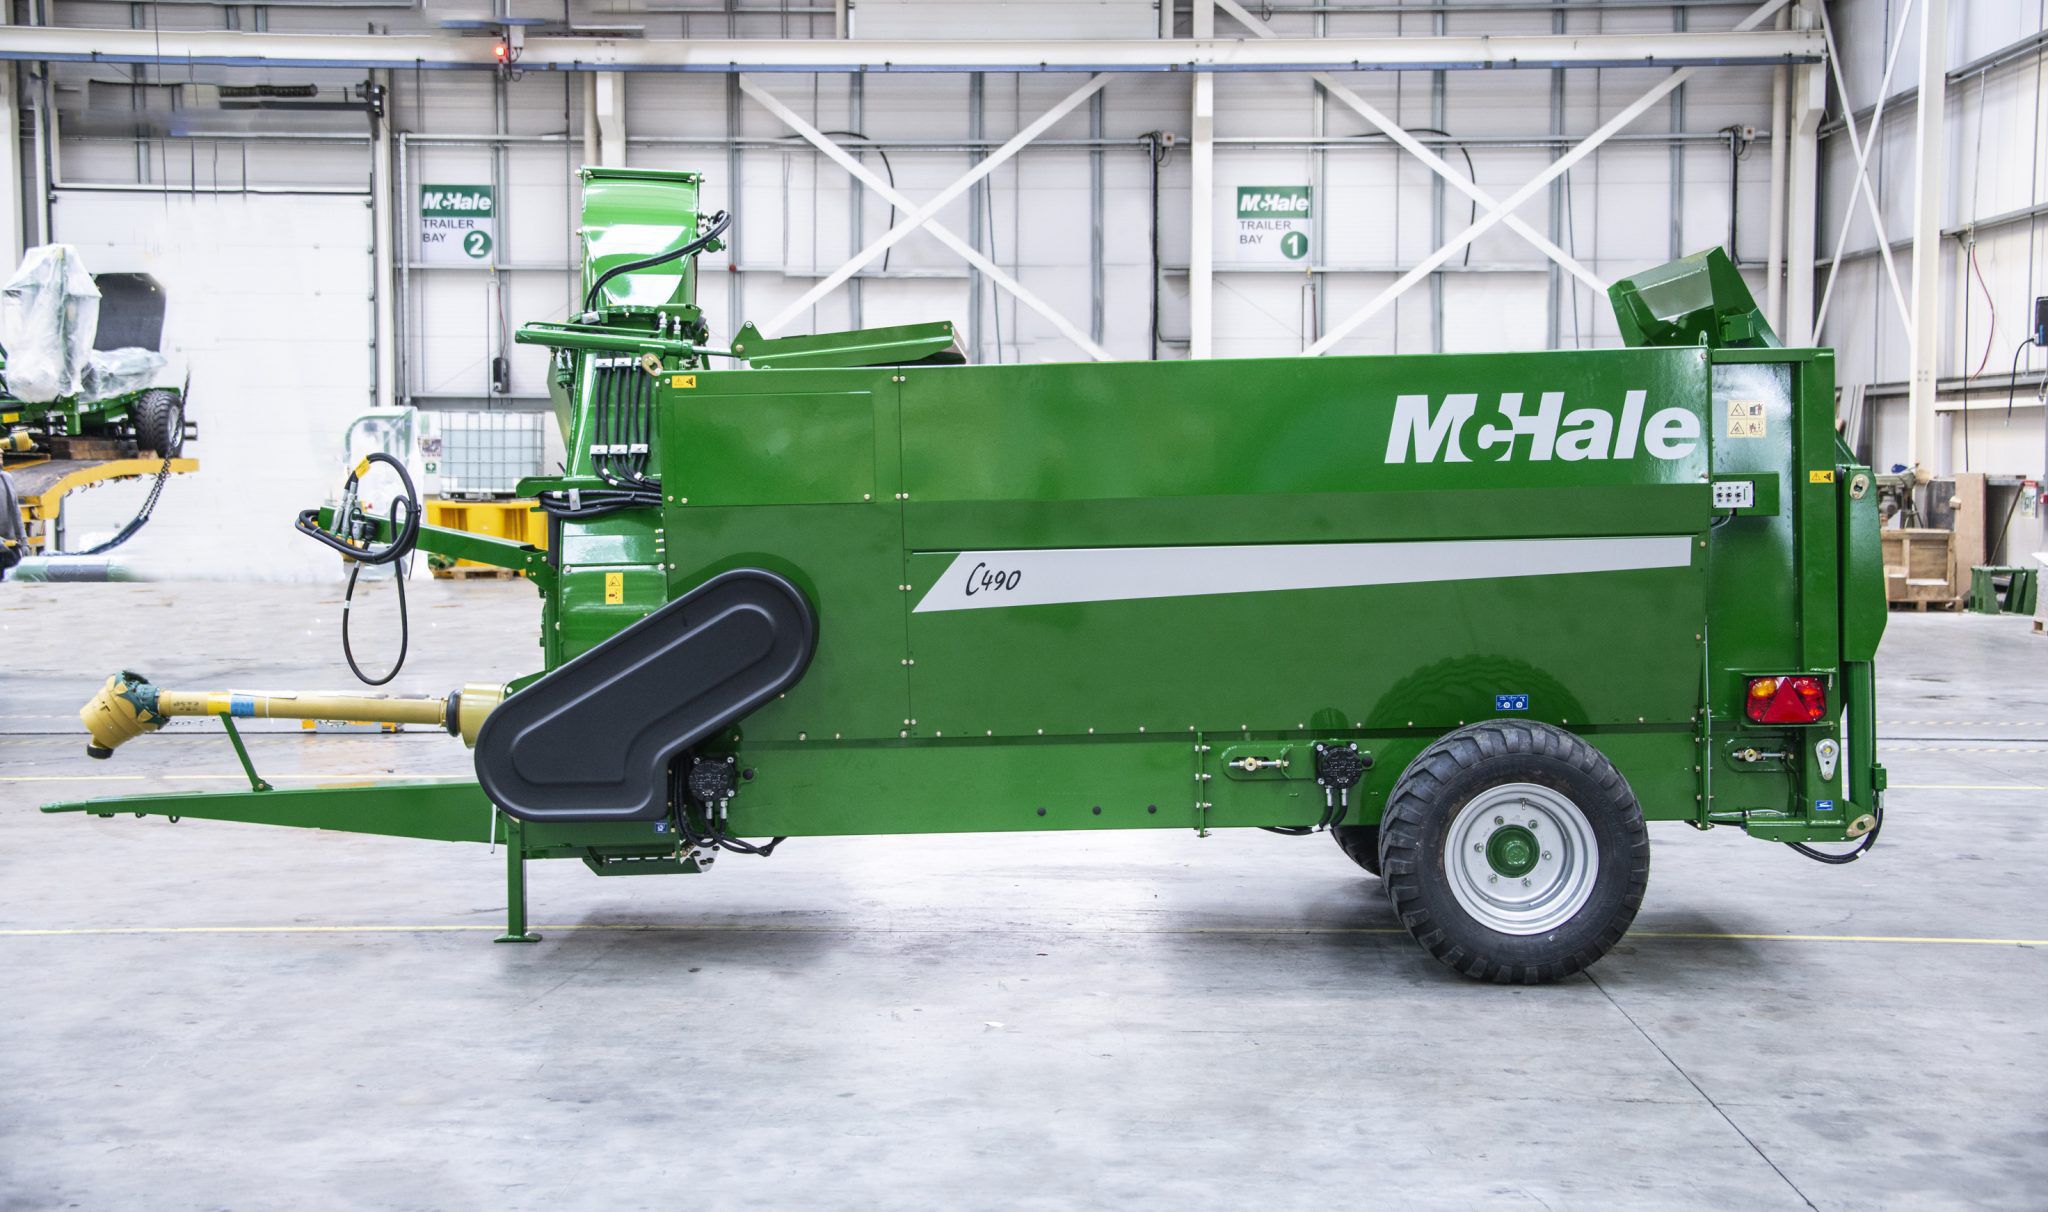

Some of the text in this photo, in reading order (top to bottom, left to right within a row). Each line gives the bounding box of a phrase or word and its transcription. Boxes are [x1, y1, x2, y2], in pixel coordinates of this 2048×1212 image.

[423, 192, 491, 210] McHale
[1240, 193, 1309, 211] McHale
[423, 219, 474, 229] TRAILER
[1240, 220, 1291, 230] TRAILER
[423, 233, 484, 255] BAY 2
[1240, 234, 1299, 256] BAY 1
[1383, 389, 1701, 464] McHale
[965, 561, 1022, 597] C490
